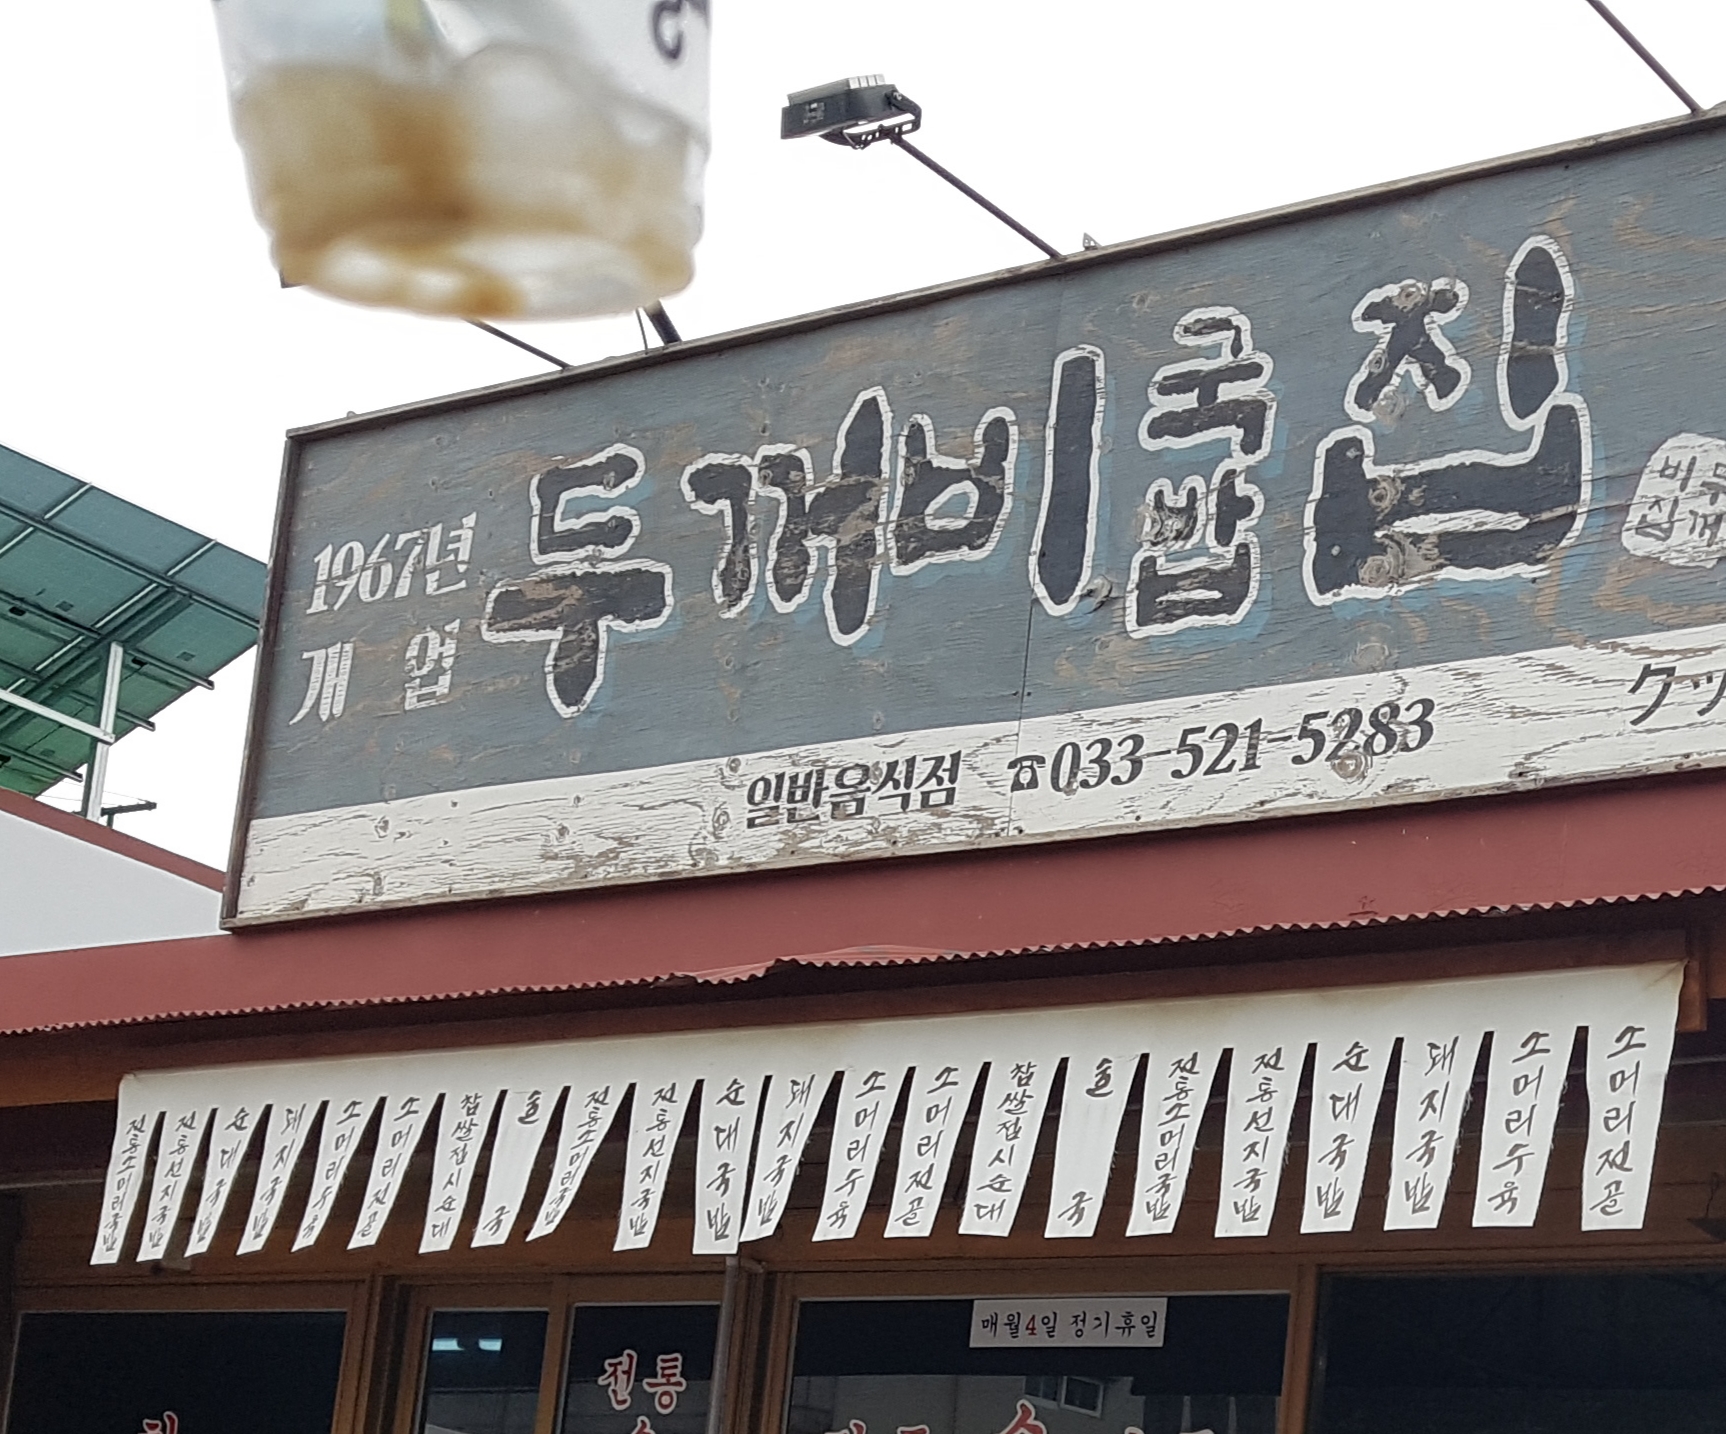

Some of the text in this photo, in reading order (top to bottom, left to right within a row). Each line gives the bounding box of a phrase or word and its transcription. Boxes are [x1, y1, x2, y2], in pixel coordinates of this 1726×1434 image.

[304, 511, 478, 617] 1967년
[745, 749, 962, 831] 일반음식점
[1051, 697, 1436, 796] 033-521-5283
[629, 1082, 678, 1237] 전통선지국밥
[706, 1078, 746, 1242] 순대국밥
[758, 1074, 816, 1227] 돼지국밥
[826, 1071, 887, 1229] 소머리수육
[894, 1066, 960, 1227] 소머리전골
[1145, 1052, 1200, 1222] 전통소머리국밥
[1232, 1046, 1285, 1223] 전통선지국밥
[1316, 1041, 1370, 1220] 순대국밥
[1404, 1035, 1459, 1215] 돼지국밥
[1487, 1031, 1551, 1215] 소머리수육
[1589, 1025, 1647, 1217] 소머리전골
[599, 1349, 687, 1415] 전통
[981, 1310, 1158, 1339] 매월4일 정기휴일
